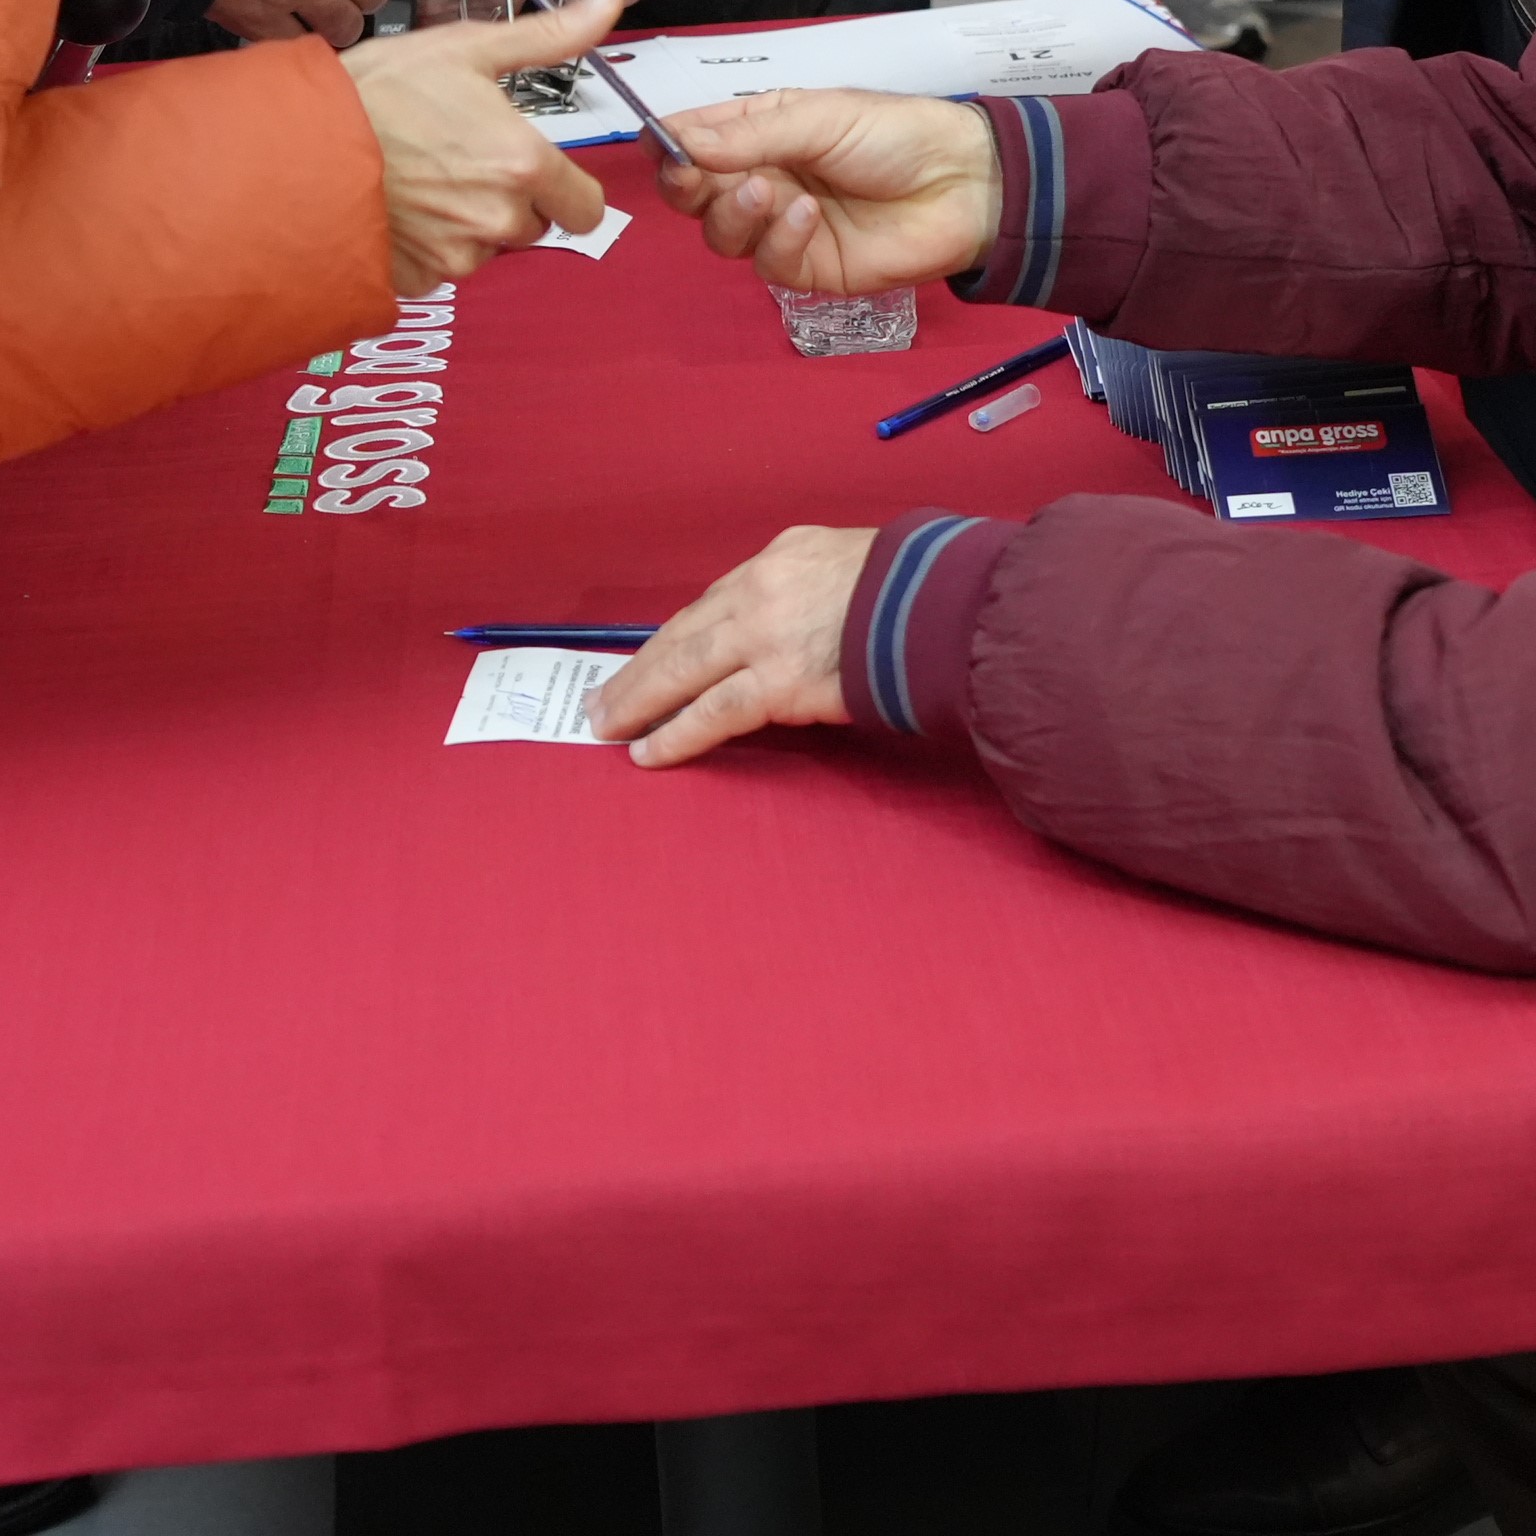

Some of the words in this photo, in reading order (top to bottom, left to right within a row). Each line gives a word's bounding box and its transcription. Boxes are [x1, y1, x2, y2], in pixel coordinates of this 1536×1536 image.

[1255, 427, 1314, 447] anpa
[1319, 424, 1379, 446] gross
[286, 381, 444, 514] gross
[1336, 489, 1368, 500] Hediye
[1370, 487, 1391, 497] Çeki
